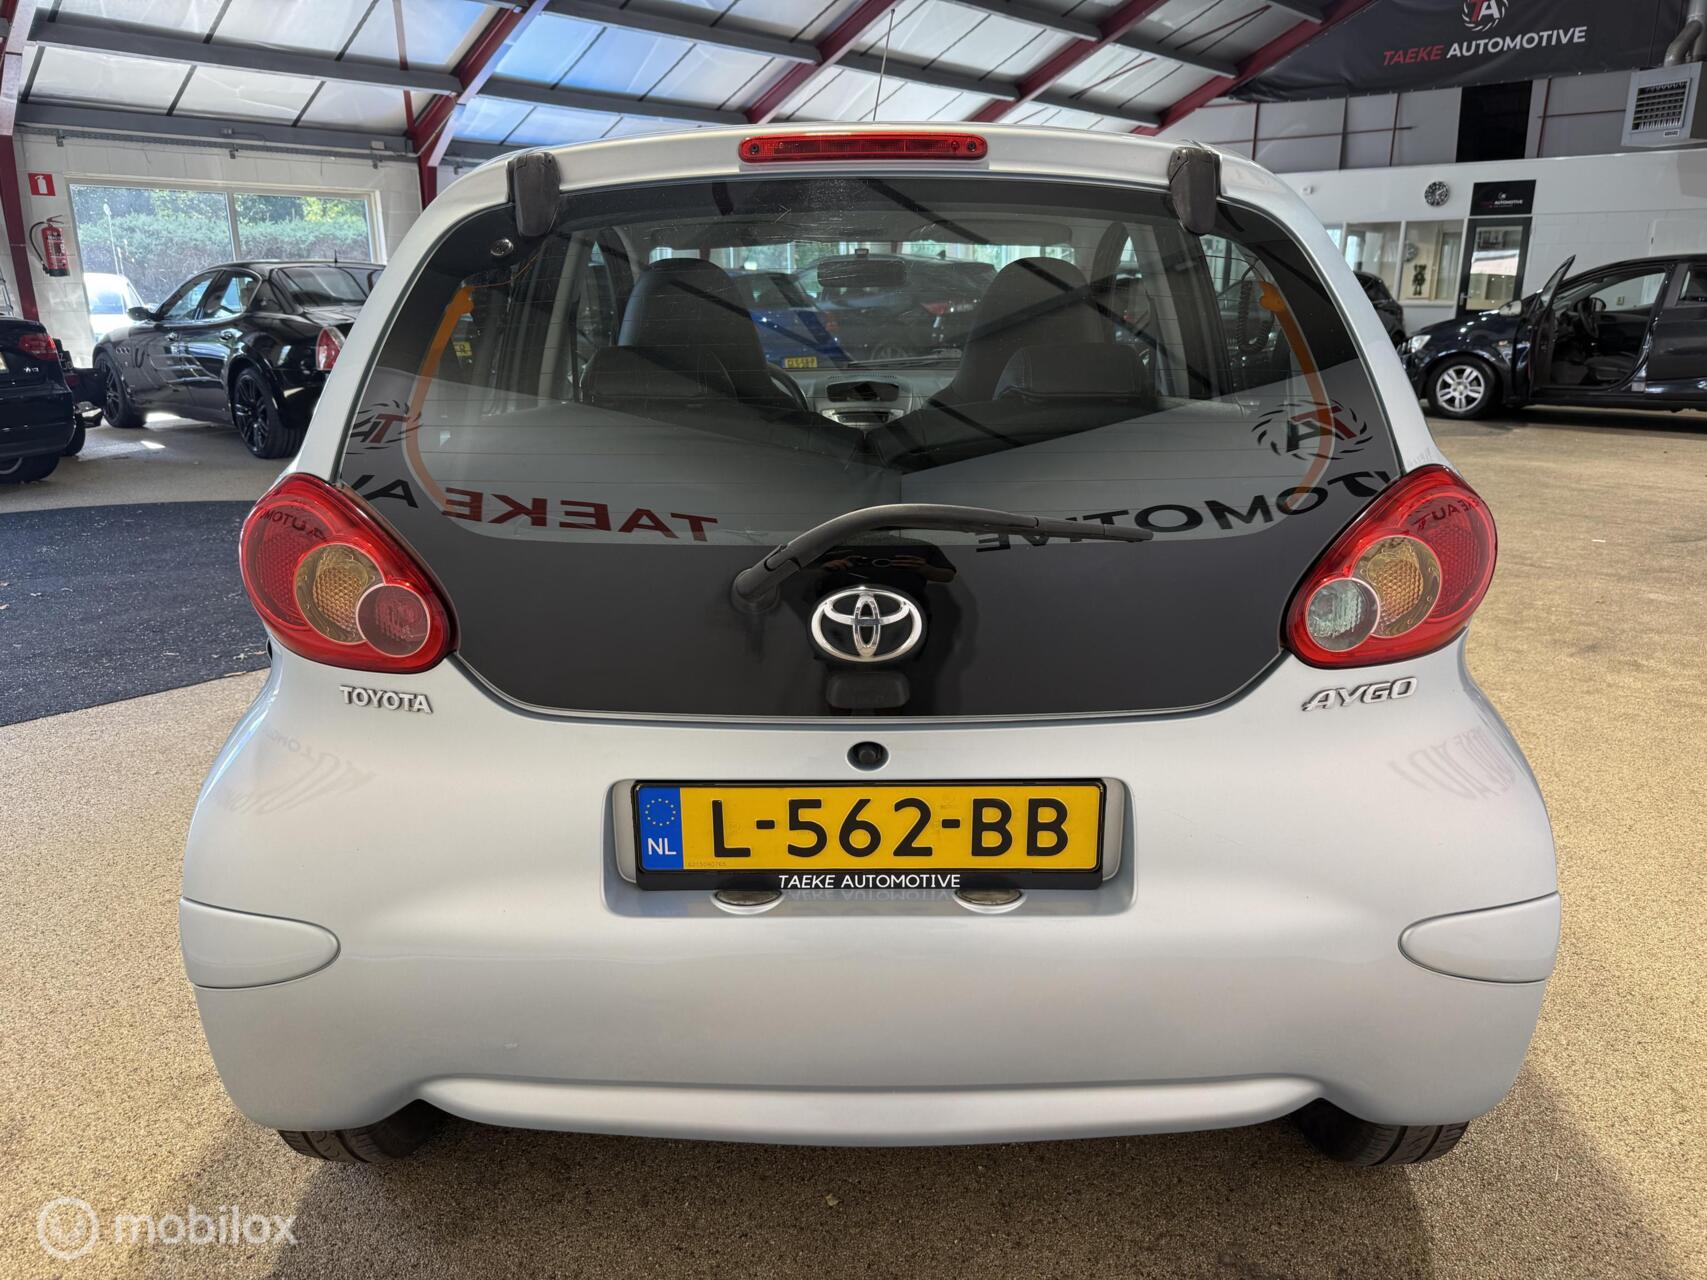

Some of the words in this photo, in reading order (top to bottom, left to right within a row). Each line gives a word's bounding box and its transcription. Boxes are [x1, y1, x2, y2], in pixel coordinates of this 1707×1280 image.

[1383, 45, 1445, 66] TAEKE
[1446, 26, 1588, 58] AUTOMOTIVE
[340, 685, 434, 714] TOYOTA
[1301, 676, 1418, 711] AYGO
[647, 837, 677, 855] NL
[711, 797, 1069, 858] L-562-BB
[778, 875, 836, 889] TAEKE
[841, 874, 961, 888] AUTOMOTIVE
